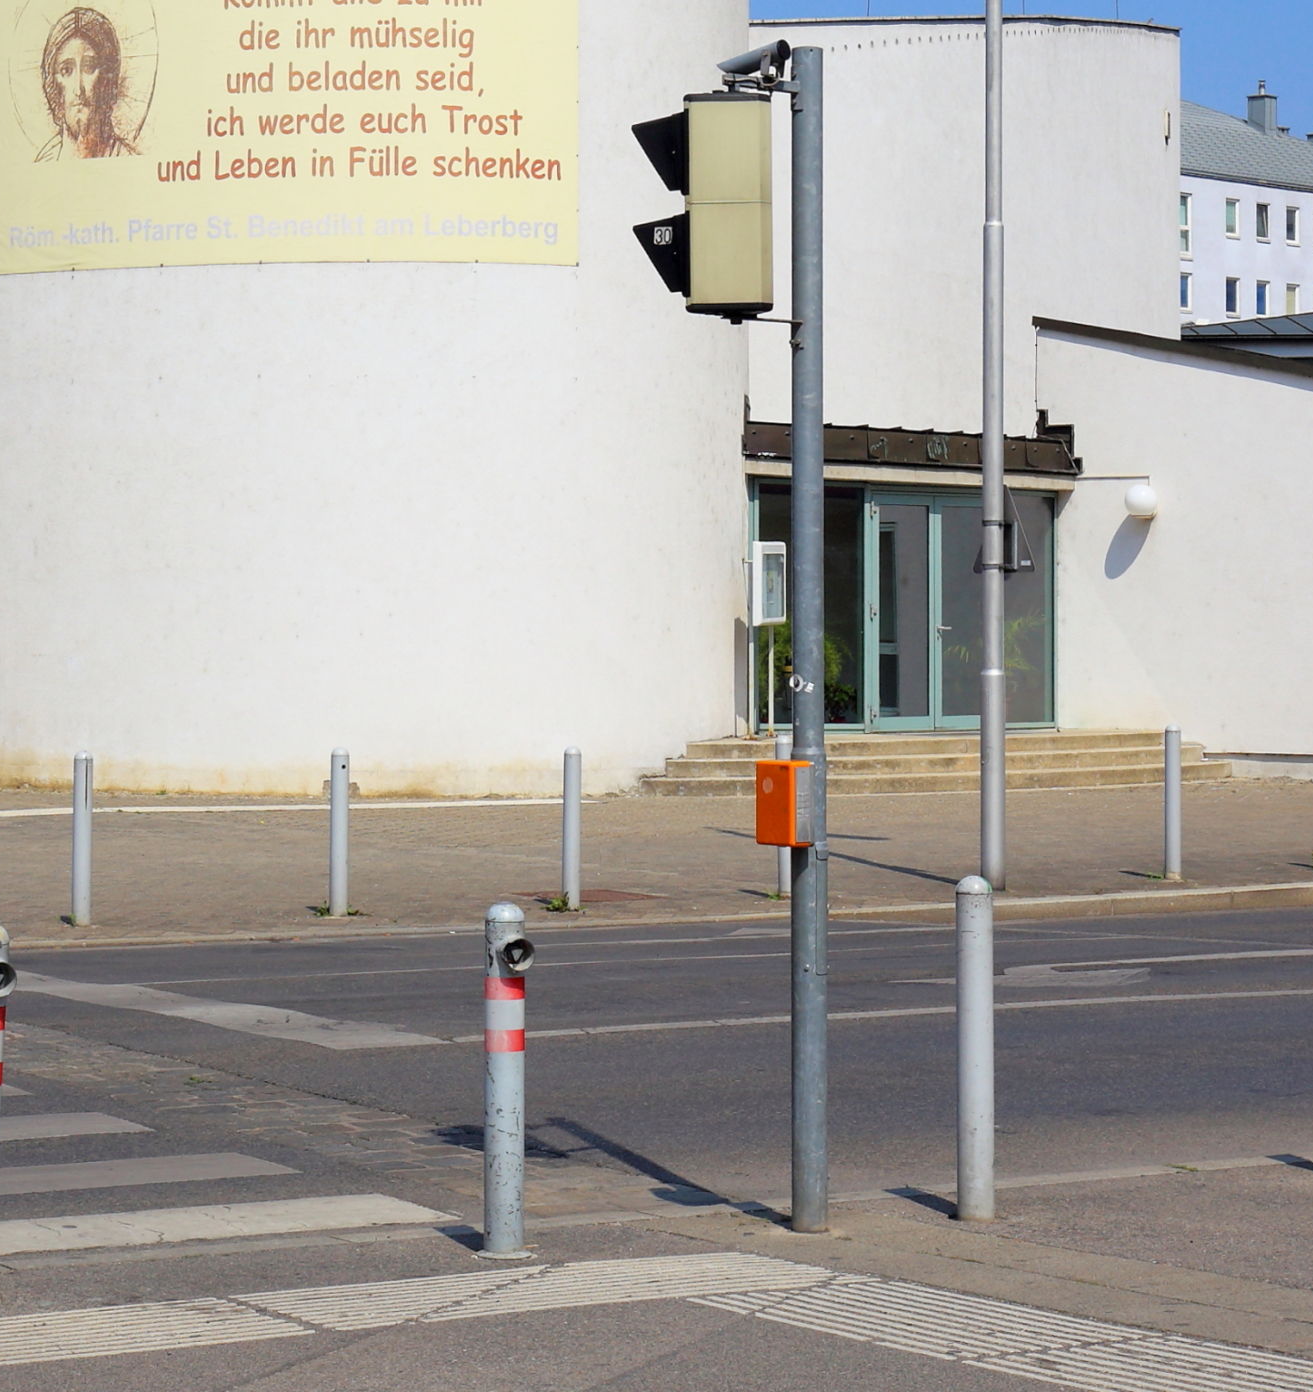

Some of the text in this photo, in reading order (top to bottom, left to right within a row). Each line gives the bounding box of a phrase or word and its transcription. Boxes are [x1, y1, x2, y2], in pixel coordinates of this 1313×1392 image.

[238, 16, 475, 59] die ihr mühselig
[225, 60, 485, 97] und beladen seid,
[206, 102, 523, 138] ich werde euch Trost
[157, 145, 562, 183] und Leben in Fülle schenken
[127, 217, 199, 243] Pfarre
[205, 215, 238, 240] St.
[247, 213, 365, 239] Benedikt
[374, 216, 415, 237] am
[422, 213, 559, 246] Leberberg
[655, 228, 672, 243] 30
